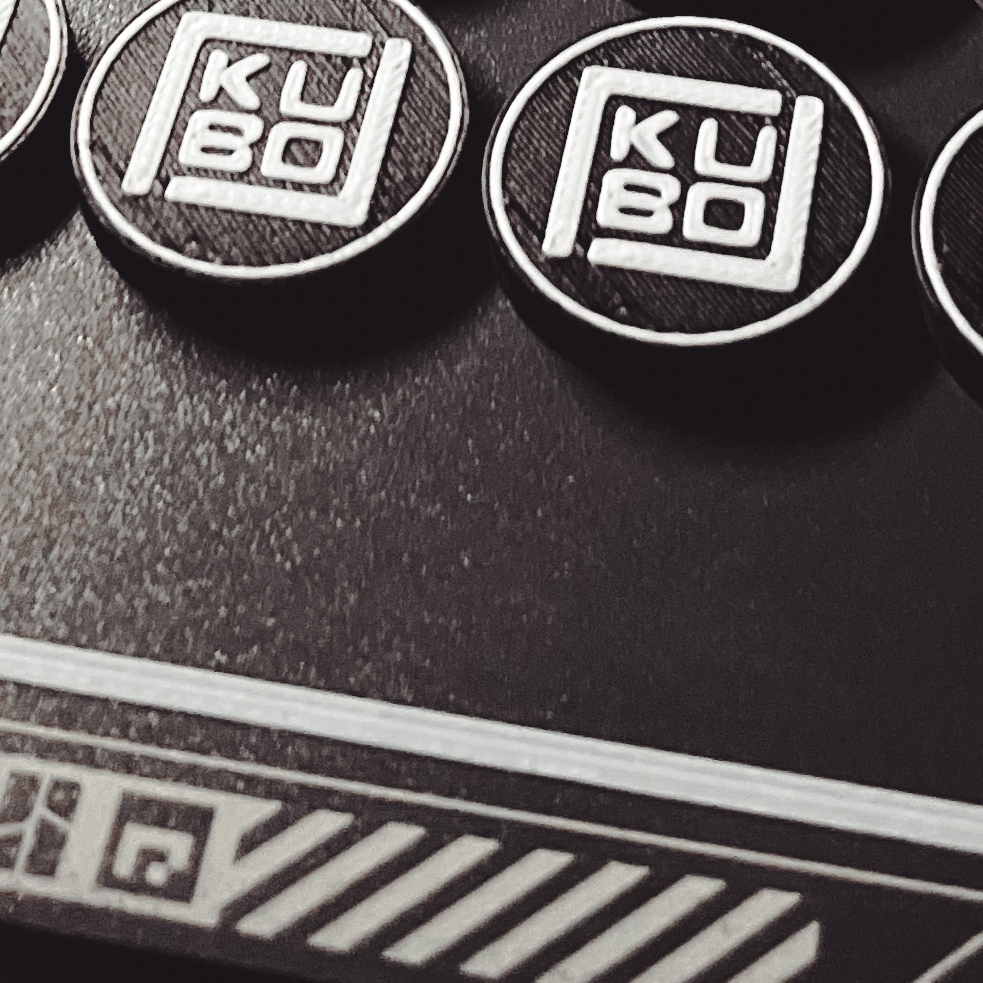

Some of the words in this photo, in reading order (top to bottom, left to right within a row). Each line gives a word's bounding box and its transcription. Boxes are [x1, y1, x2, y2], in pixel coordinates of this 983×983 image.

[198, 49, 364, 121] KU
[178, 109, 344, 183] BO
[610, 105, 777, 181] KU
[596, 168, 765, 246] BO
